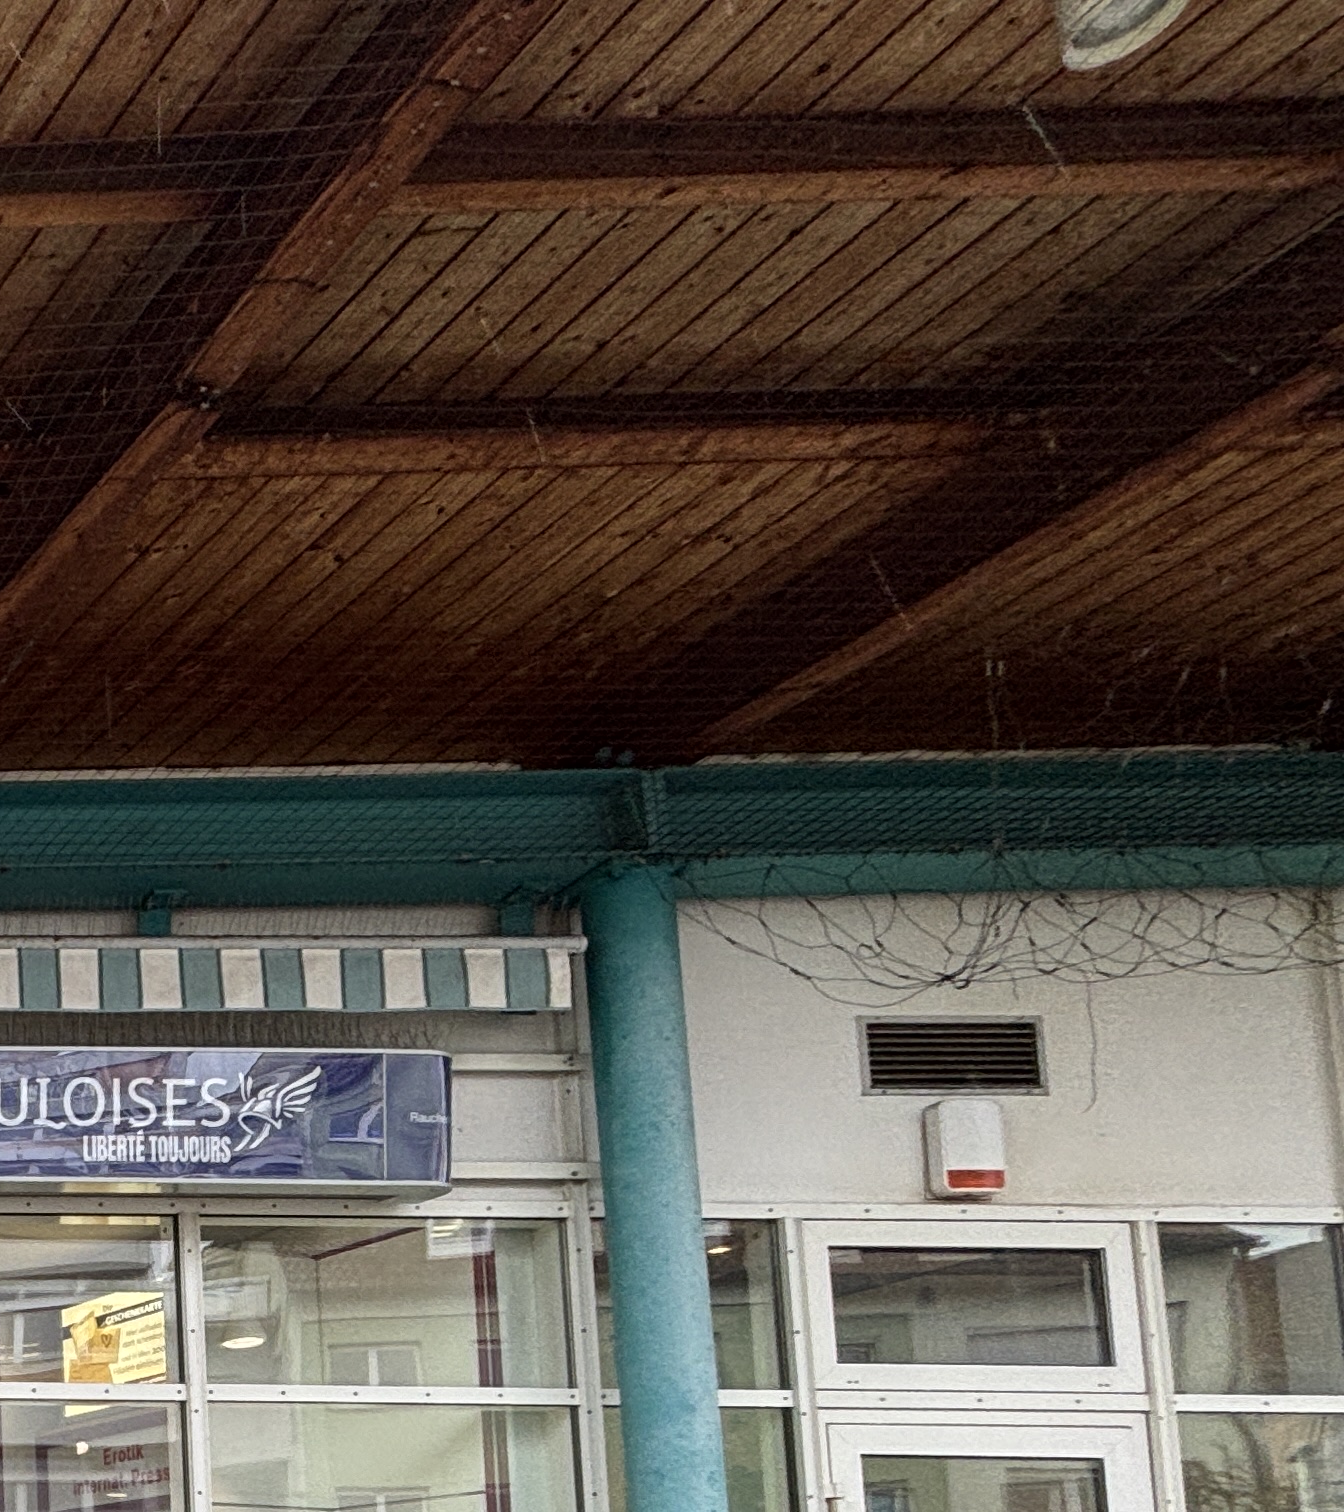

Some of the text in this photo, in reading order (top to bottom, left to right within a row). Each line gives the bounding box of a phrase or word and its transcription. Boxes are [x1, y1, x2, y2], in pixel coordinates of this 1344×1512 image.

[83, 1128, 231, 1164] LIBERTÉ TOUJOURS
[102, 1444, 145, 1466] Erotik
